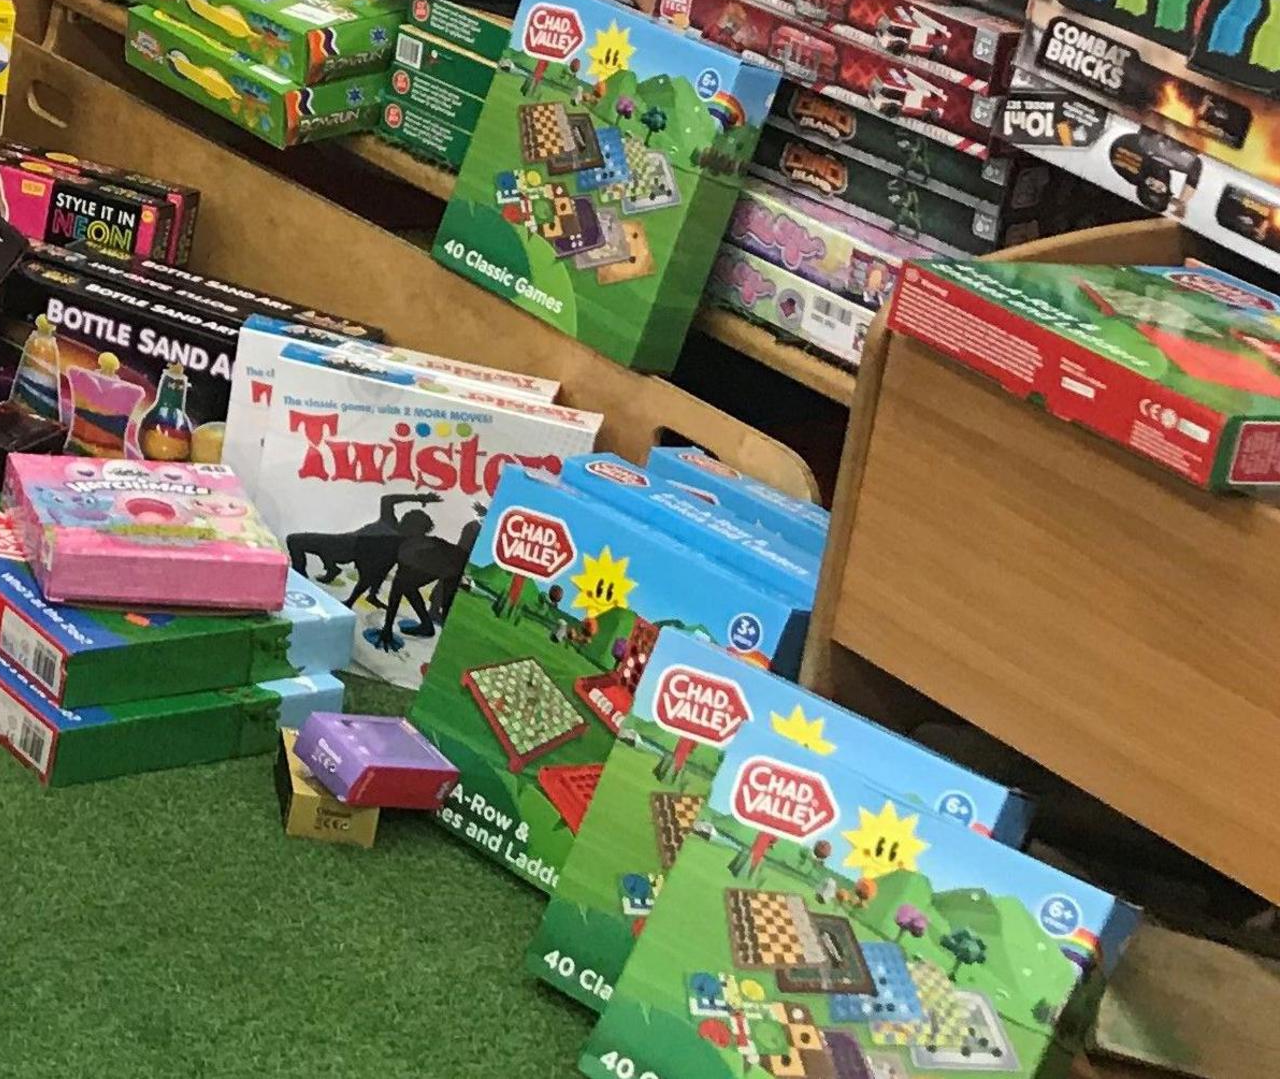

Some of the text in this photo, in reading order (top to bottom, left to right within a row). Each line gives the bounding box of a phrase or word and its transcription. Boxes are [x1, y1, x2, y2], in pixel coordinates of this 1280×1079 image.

[532, 10, 571, 35] CHAD
[528, 27, 579, 54] VALLEY
[1052, 20, 1131, 67] COMBAT
[1044, 38, 1125, 91] BRICKS
[56, 192, 136, 227] STYLE IT IN
[52, 210, 134, 251] NEON
[444, 238, 565, 315] 40 Classic Games
[85, 282, 145, 308] BOTTLE
[46, 298, 211, 372] BOTTLE SAND
[283, 395, 303, 407] The
[506, 519, 556, 548] CHAD
[500, 534, 564, 570] VALLEY
[668, 679, 726, 708] CHAD
[663, 696, 741, 738] VALLEY
[748, 769, 812, 803] CHAD
[742, 789, 827, 832] VALLEY
[466, 821, 504, 853] and
[514, 821, 531, 843] &
[1046, 898, 1075, 922] 6+
[543, 950, 576, 977] 40
[599, 1051, 633, 1079] 40
